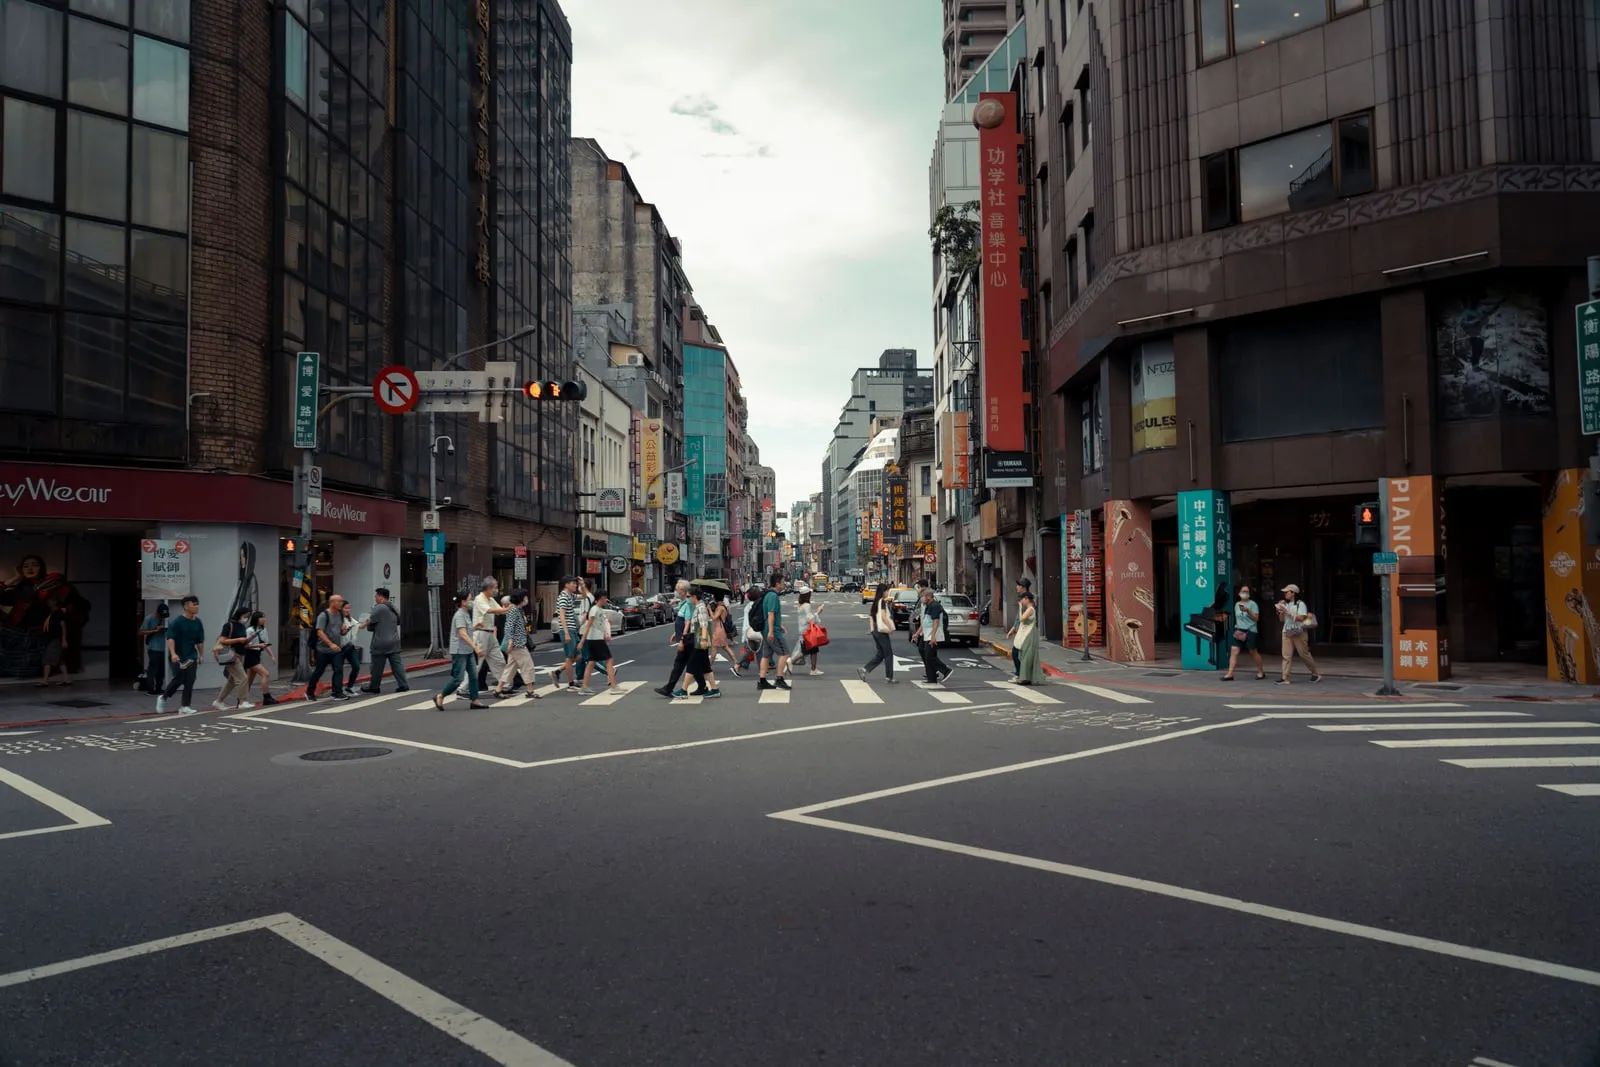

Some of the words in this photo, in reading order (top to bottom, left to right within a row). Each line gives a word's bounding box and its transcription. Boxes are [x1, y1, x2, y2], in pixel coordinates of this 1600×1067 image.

[987, 147, 1006, 206] 功学社
[988, 212, 1007, 287] 音樂中心
[1584, 318, 1600, 385] 衡陽路
[301, 365, 315, 417] 博愛路
[323, 498, 368, 524] KeyWear
[1215, 498, 1226, 576] 五大保證
[1182, 523, 1191, 560] 全國最大
[1194, 499, 1208, 588] 中古鋼琴中心
[1083, 557, 1096, 595] 招生中
[1399, 655, 1429, 668] 鋼琴
